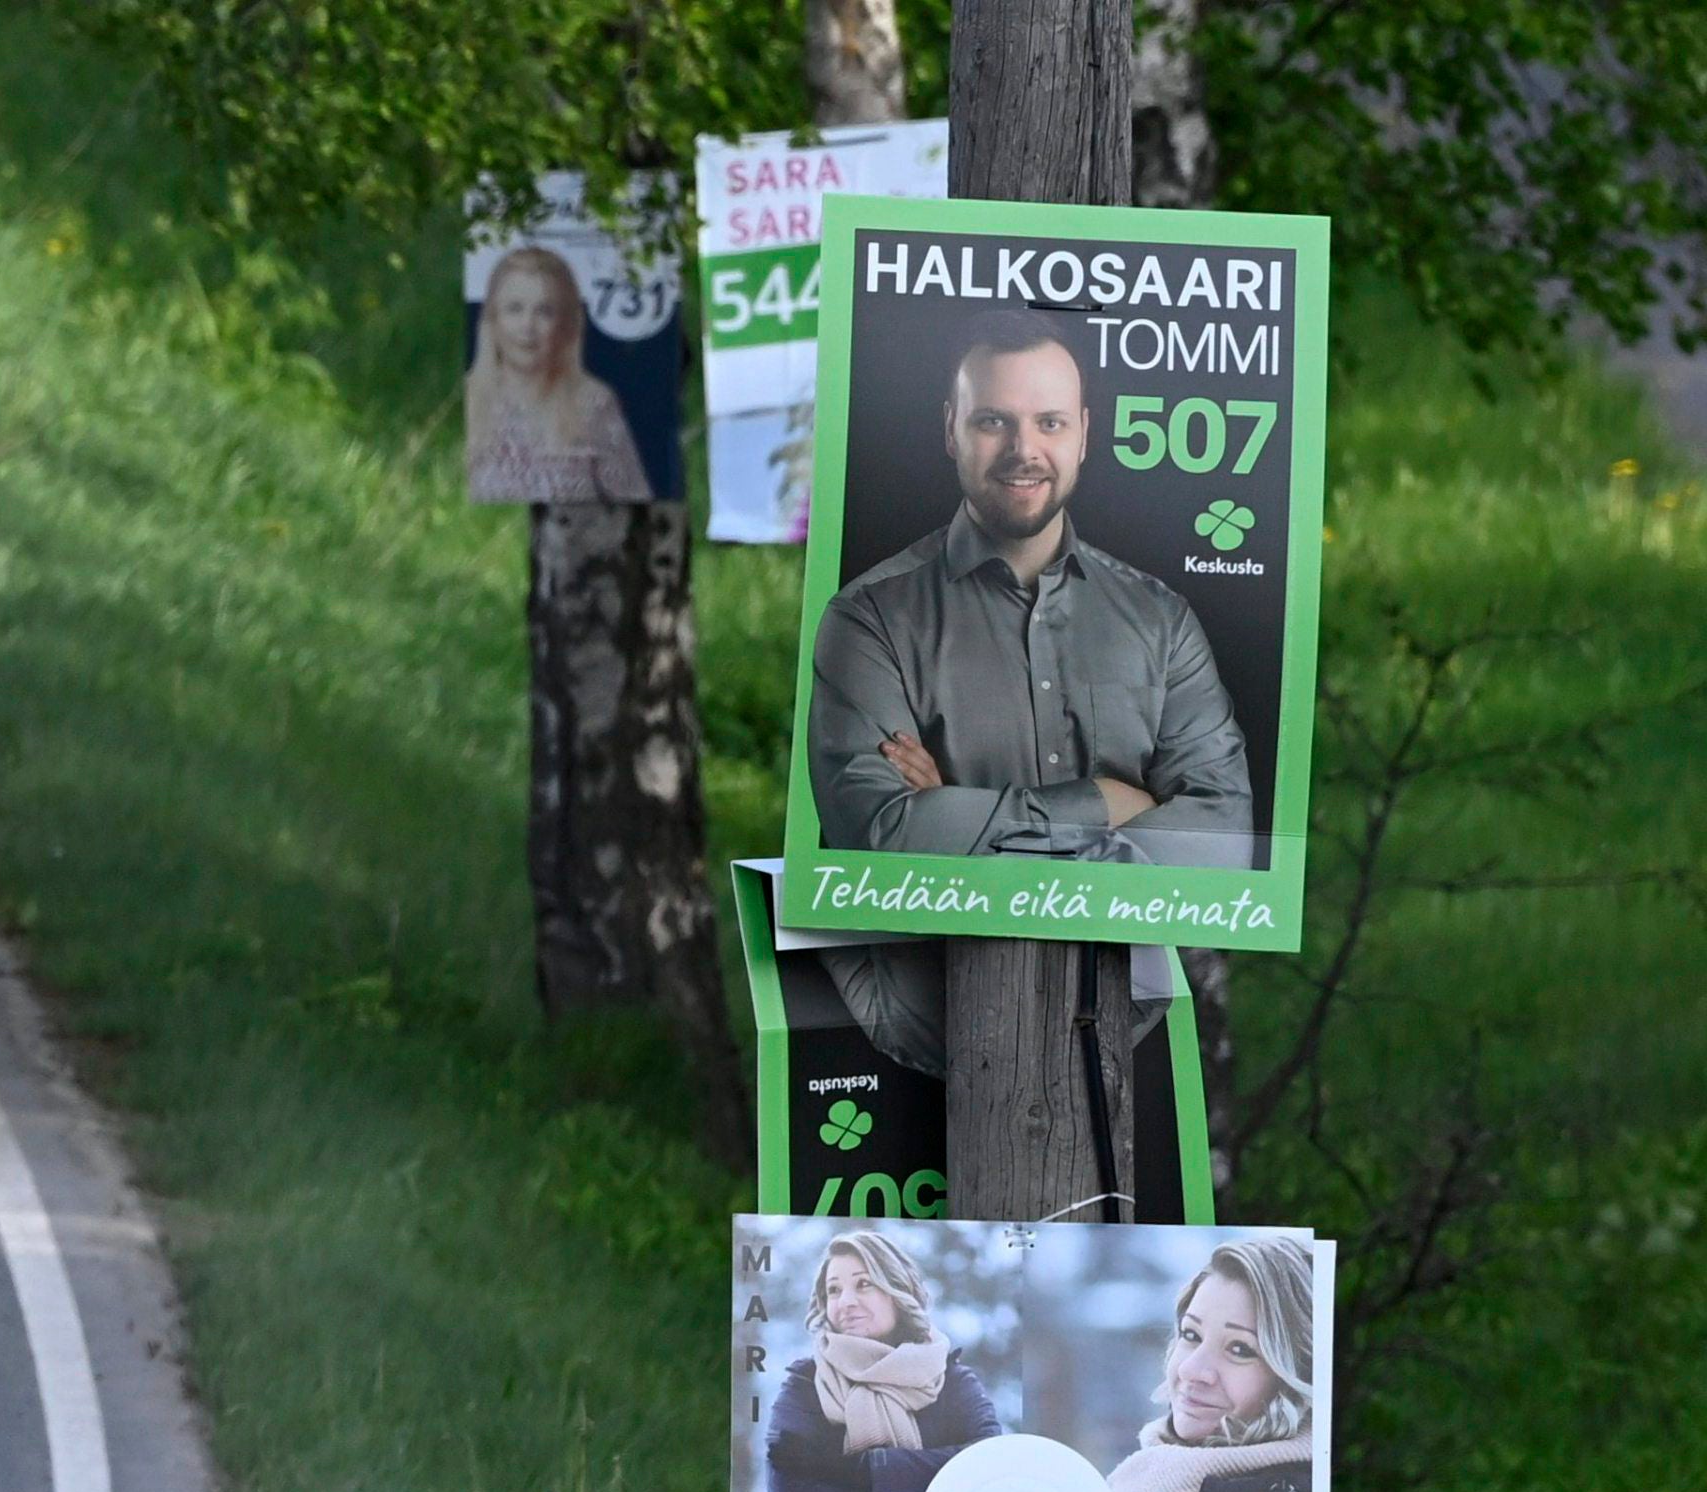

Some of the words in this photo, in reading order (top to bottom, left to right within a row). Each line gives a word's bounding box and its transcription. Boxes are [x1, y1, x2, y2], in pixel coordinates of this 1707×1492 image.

[725, 154, 843, 195] SARA
[728, 205, 822, 246] SAR
[592, 279, 665, 320] 731
[866, 242, 1283, 312] HALKOSAARI
[1087, 317, 1280, 376] TOMMI
[1112, 395, 1278, 475] 507
[1184, 555, 1264, 575] Keskusta
[811, 865, 990, 913] Tehdään
[1009, 878, 1092, 920] eikä
[1107, 888, 1275, 933] meinata
[809, 1074, 879, 1096] Keskusta
[741, 1244, 772, 1423] MARI
